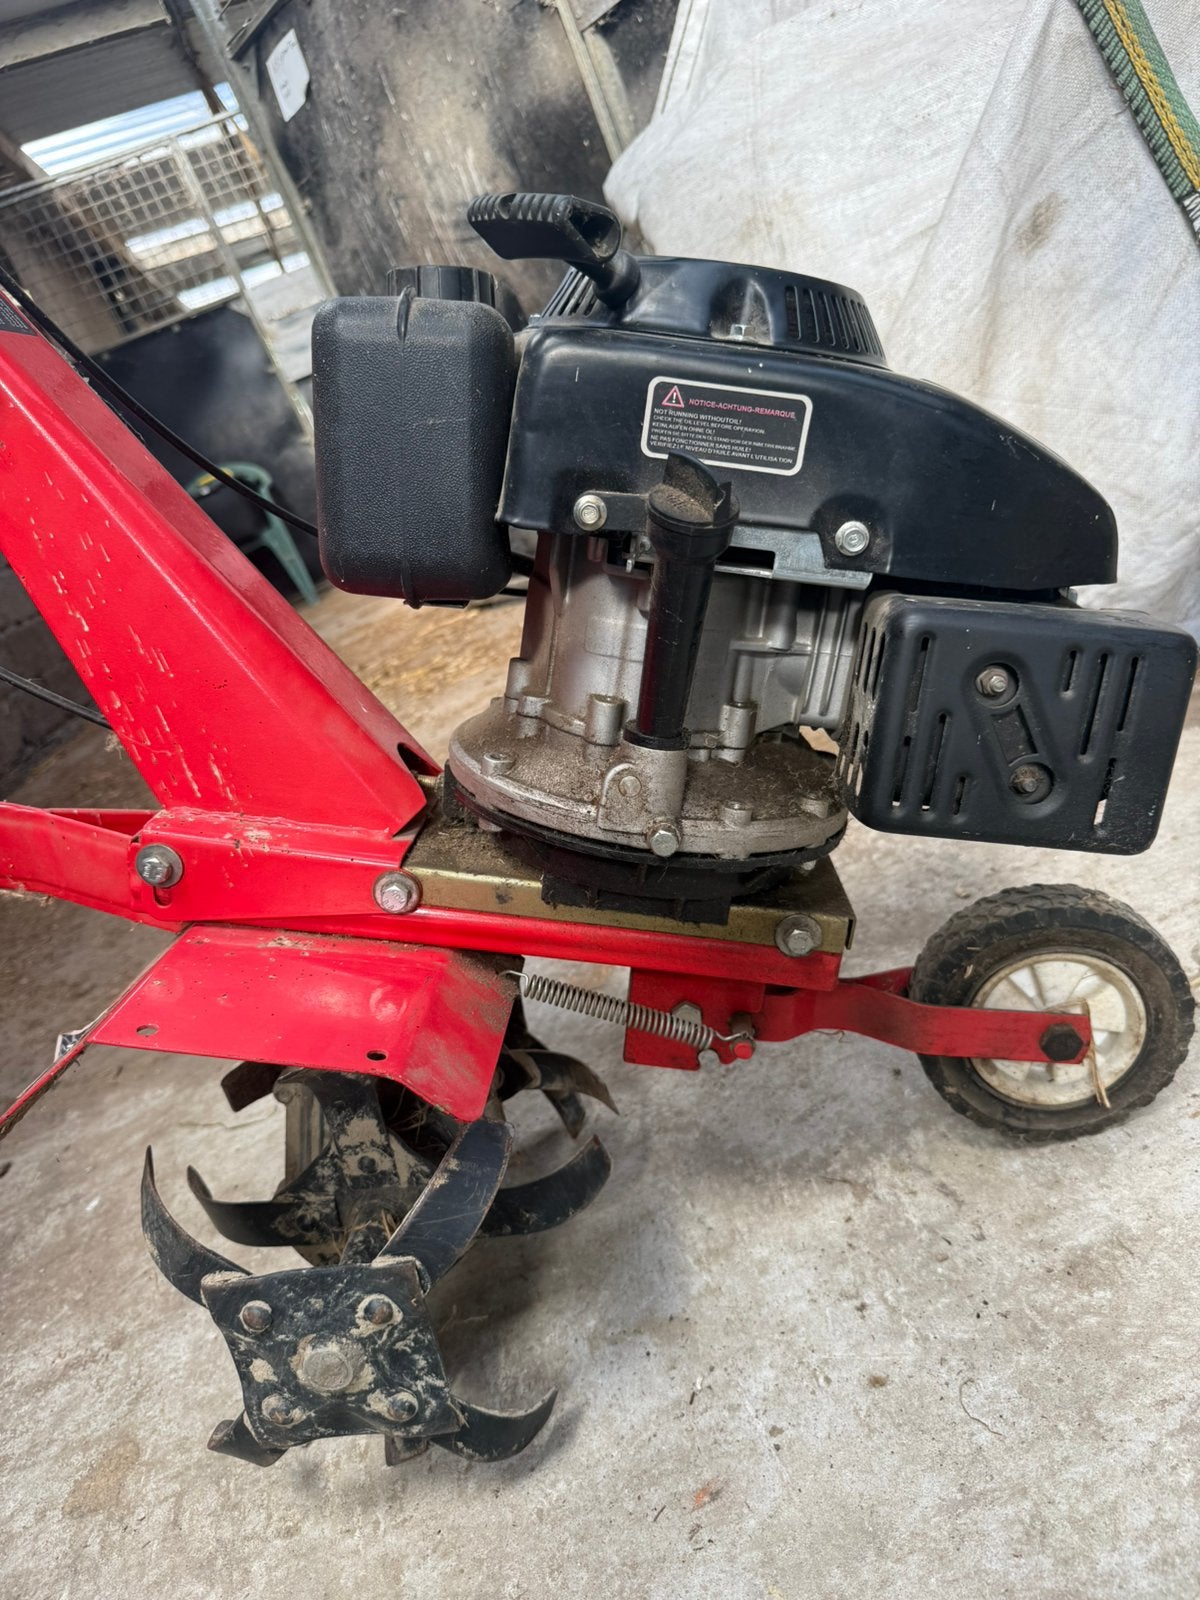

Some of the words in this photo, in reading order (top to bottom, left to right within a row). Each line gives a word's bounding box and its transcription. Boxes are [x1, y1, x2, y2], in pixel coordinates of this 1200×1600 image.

[688, 399, 796, 418] NOTICE-ACHTUNG-REMARQUE
[669, 410, 698, 418] RUNNING
[672, 437, 715, 447] FONCTIONNER
